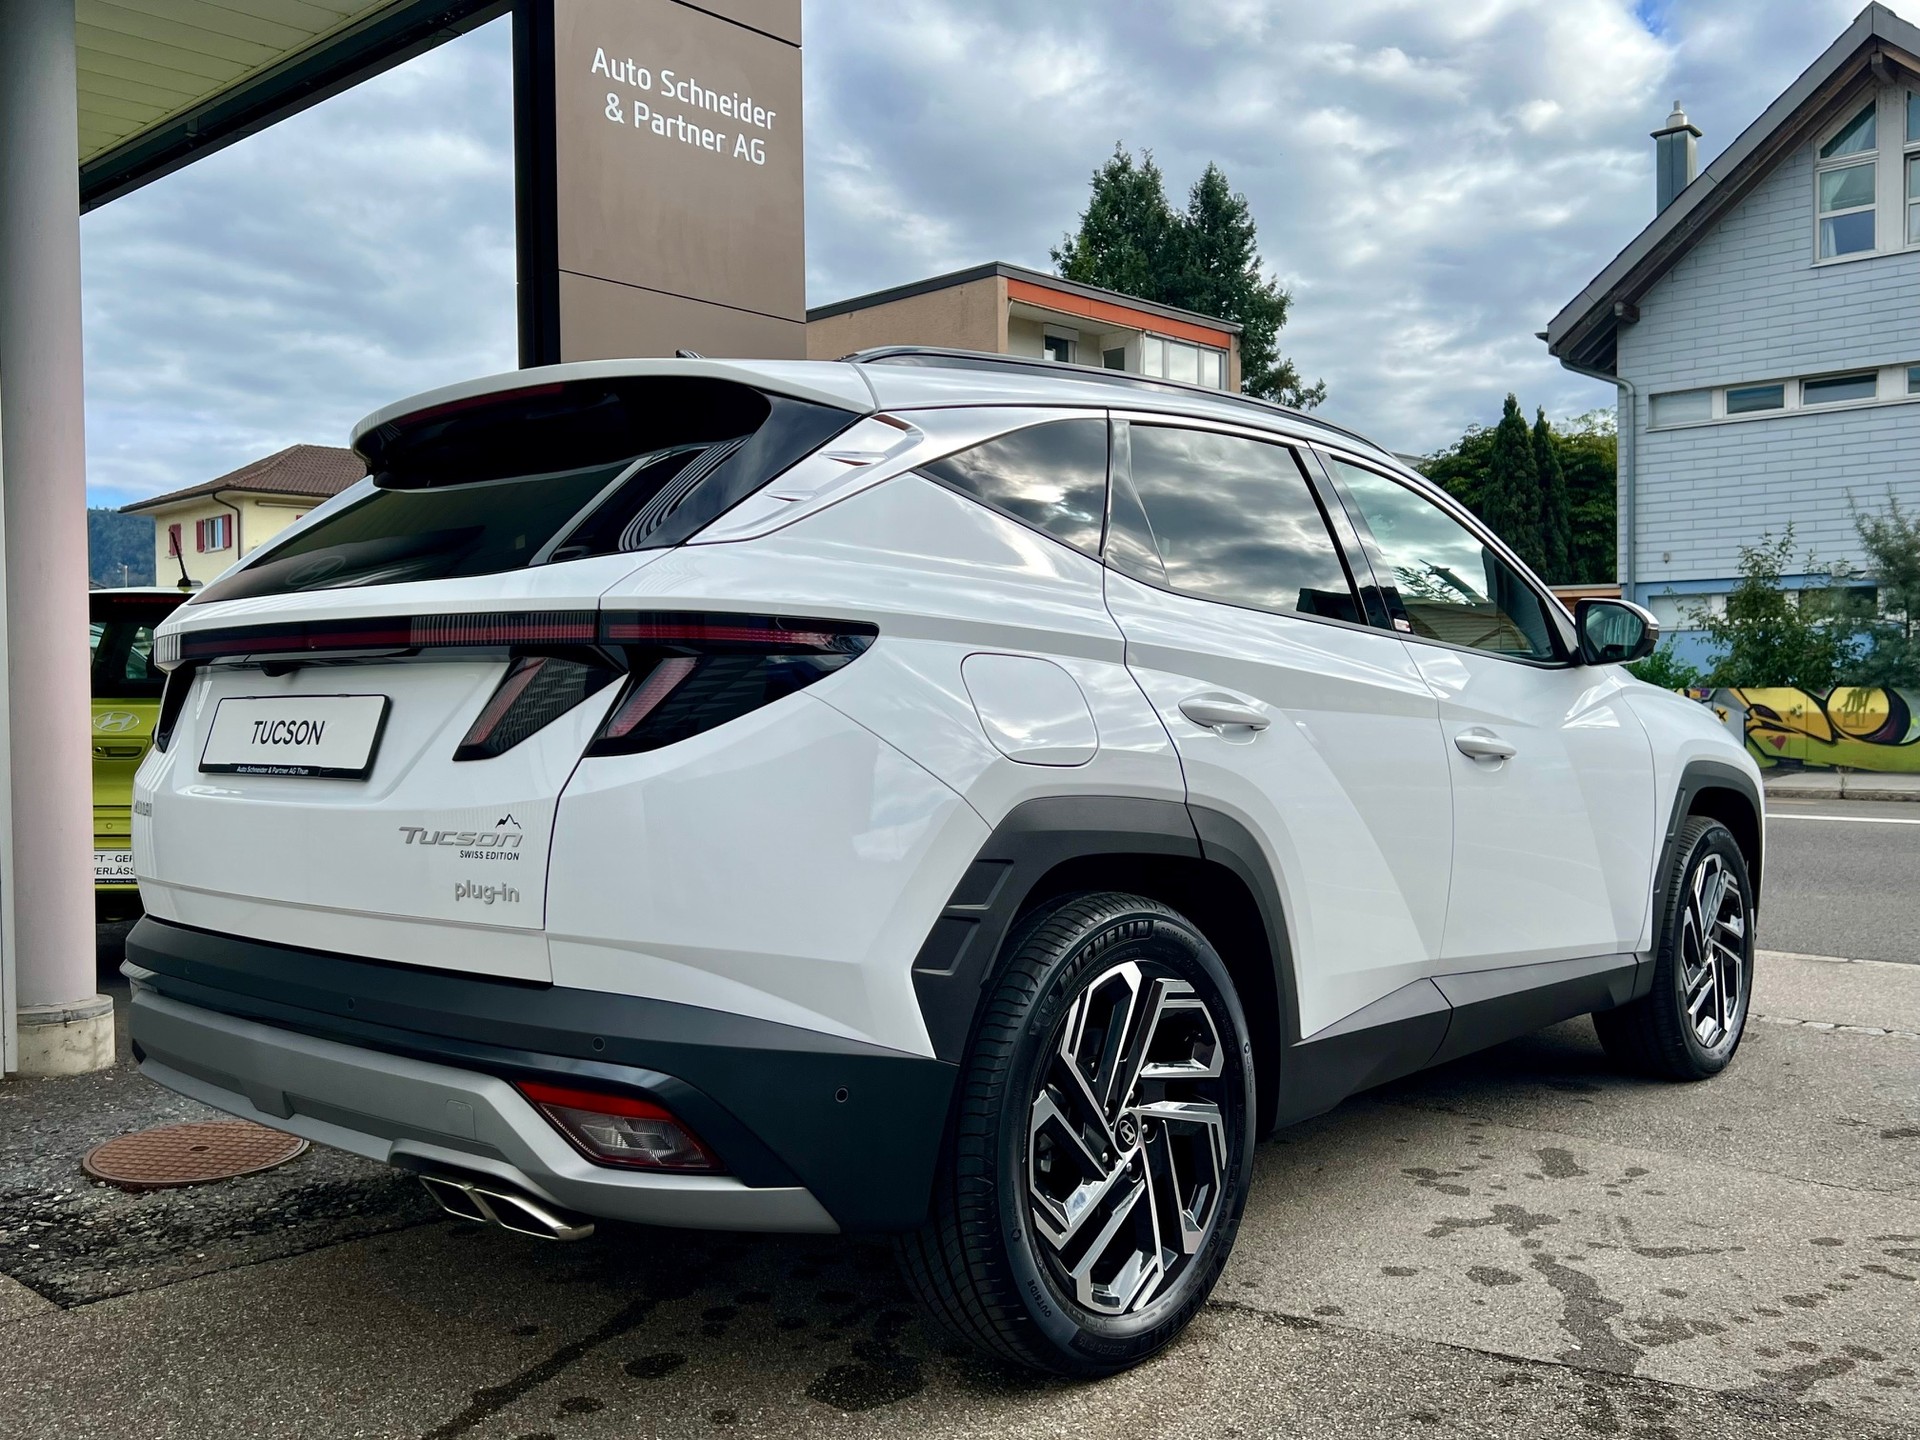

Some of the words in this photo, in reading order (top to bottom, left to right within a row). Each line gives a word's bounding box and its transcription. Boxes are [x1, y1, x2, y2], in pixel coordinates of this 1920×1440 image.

[591, 47, 652, 91] Auto
[660, 69, 776, 130] Schneider
[604, 92, 625, 124] &
[633, 100, 726, 153] Partner
[733, 133, 766, 165] AG
[251, 720, 326, 746] TUCSON
[236, 765, 248, 773] Auto
[247, 765, 269, 774] Schneider
[272, 766, 289, 775] Partner
[288, 767, 297, 775] AG
[399, 826, 524, 848] Tucson
[459, 850, 484, 860] SWISS
[485, 851, 520, 861] EDITION
[455, 879, 520, 906] plug-in
[1058, 920, 1150, 994] MICHELIN
[1028, 1278, 1052, 1318] OUTSIDE
